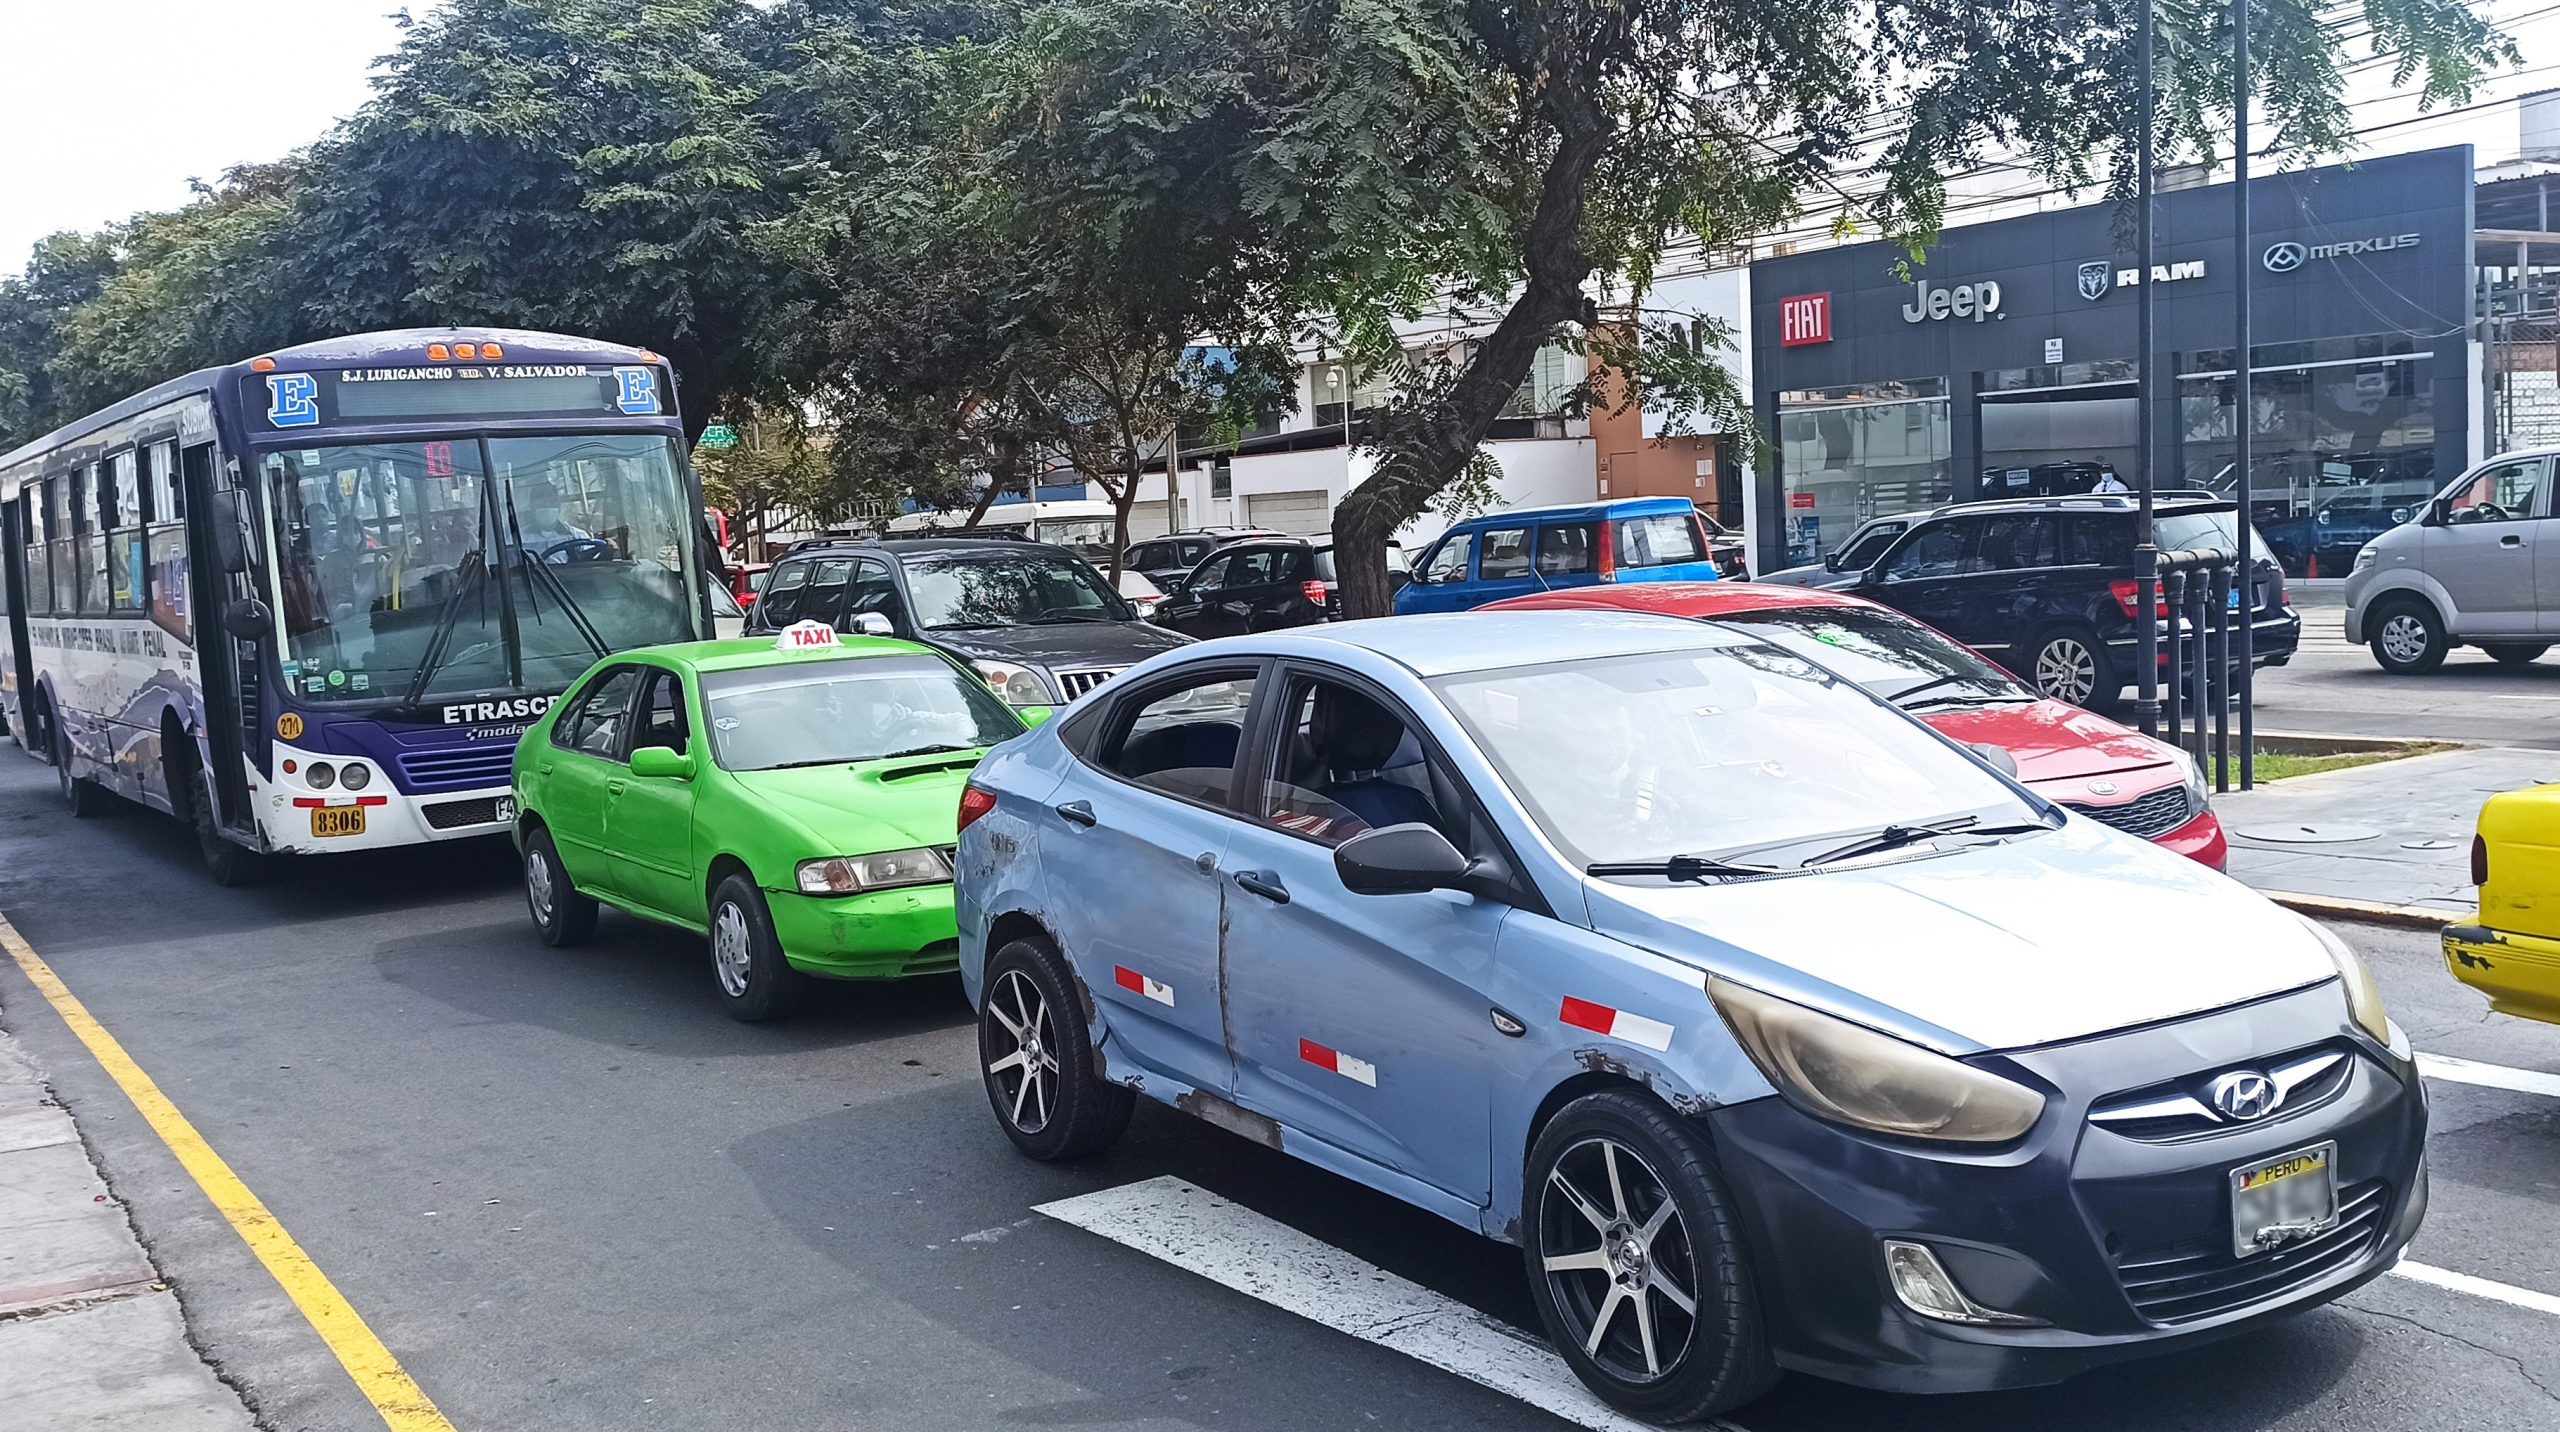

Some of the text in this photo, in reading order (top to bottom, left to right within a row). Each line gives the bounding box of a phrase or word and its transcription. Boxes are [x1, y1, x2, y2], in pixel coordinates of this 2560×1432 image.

[2310, 233, 2420, 259] MAXUS
[2117, 261, 2205, 286] RAM
[1902, 280, 2000, 323] Jeep
[1784, 298, 1824, 341] FIAT
[342, 370, 364, 382] S.J.
[367, 368, 452, 381] LURIGANCHO
[487, 367, 500, 378] V.
[504, 366, 587, 378] SALVADOR
[266, 373, 319, 428] E
[613, 366, 658, 415] E
[791, 629, 831, 645] TAXI
[318, 810, 360, 832] 8306
[2265, 1157, 2301, 1181] PERU
